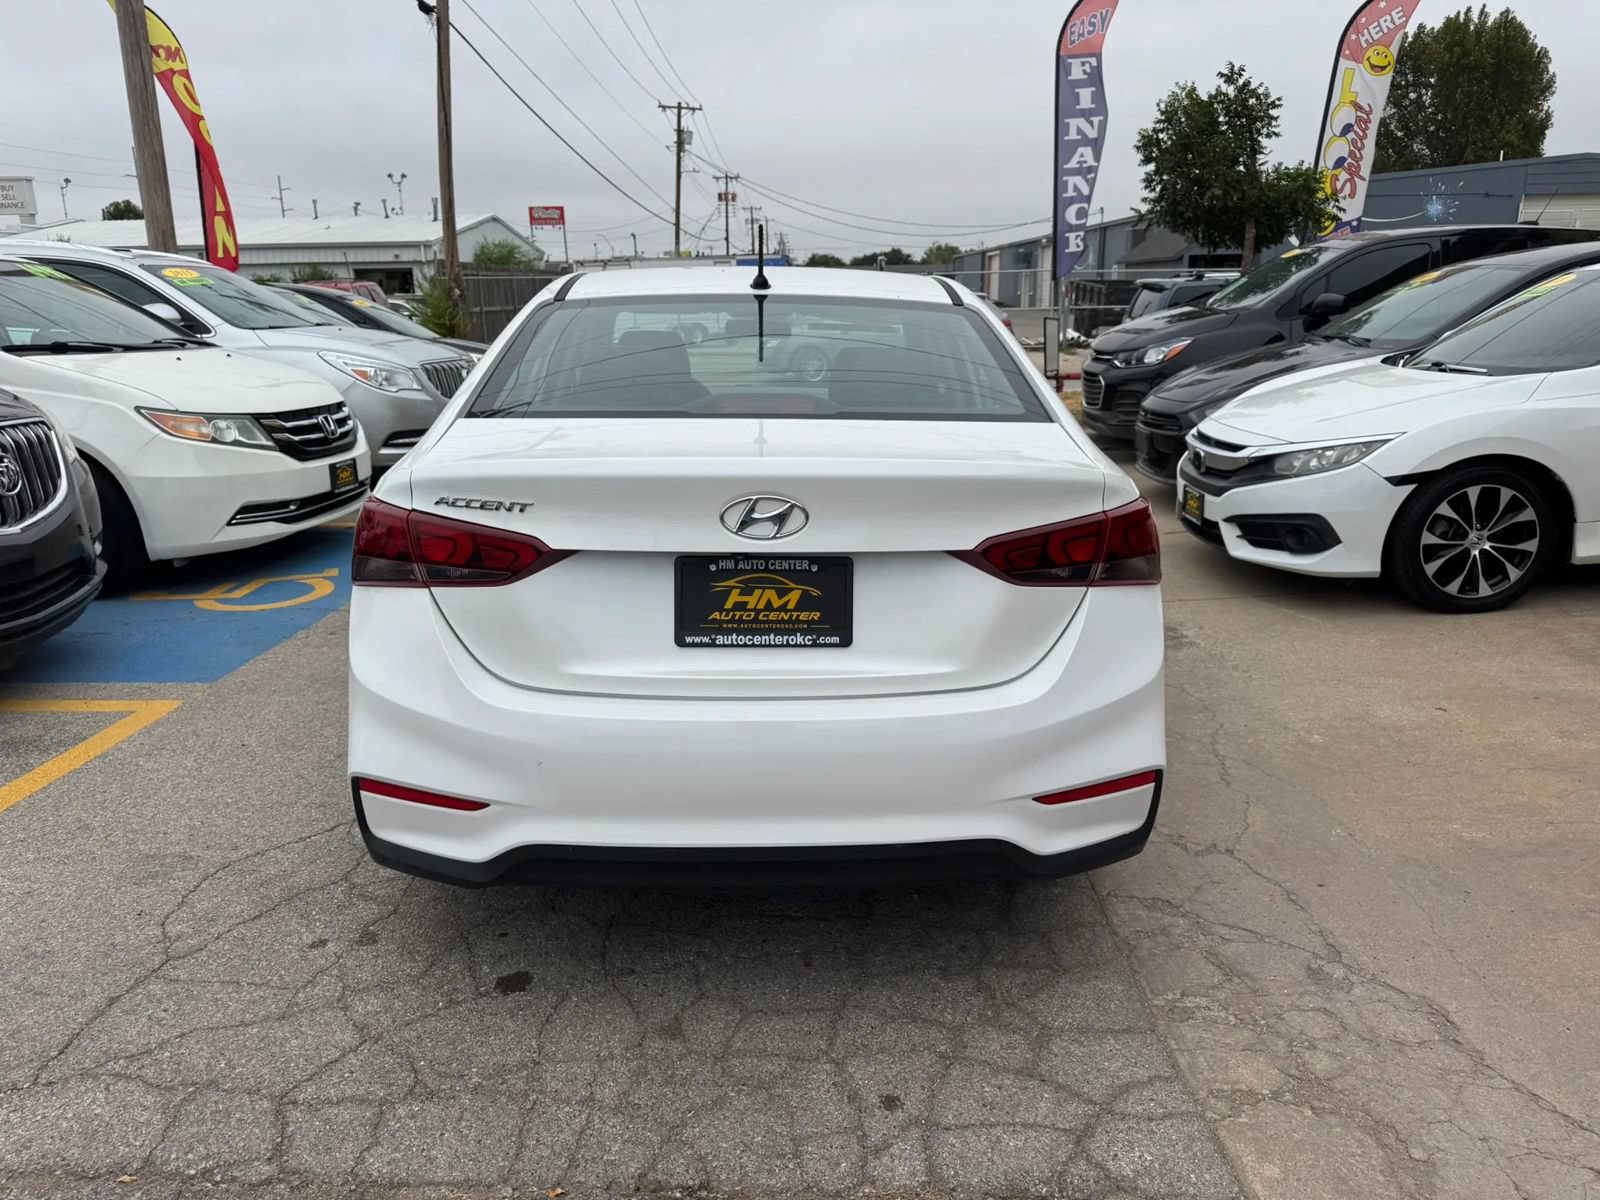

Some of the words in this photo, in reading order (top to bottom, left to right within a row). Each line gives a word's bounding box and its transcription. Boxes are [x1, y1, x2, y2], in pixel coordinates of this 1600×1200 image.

[1068, 8, 1111, 48] EASY
[1358, 6, 1407, 48] HERE
[1062, 57, 1103, 254] FINANCE
[1330, 100, 1373, 199] Special
[0, 184, 14, 192] BUY
[433, 495, 535, 513] ACCENT
[718, 559, 735, 571] HM
[737, 559, 765, 571] AUTO
[768, 559, 810, 571] CENTER
[723, 588, 802, 609] HM
[707, 611, 756, 621] AUTO
[758, 611, 821, 621] CENTER
